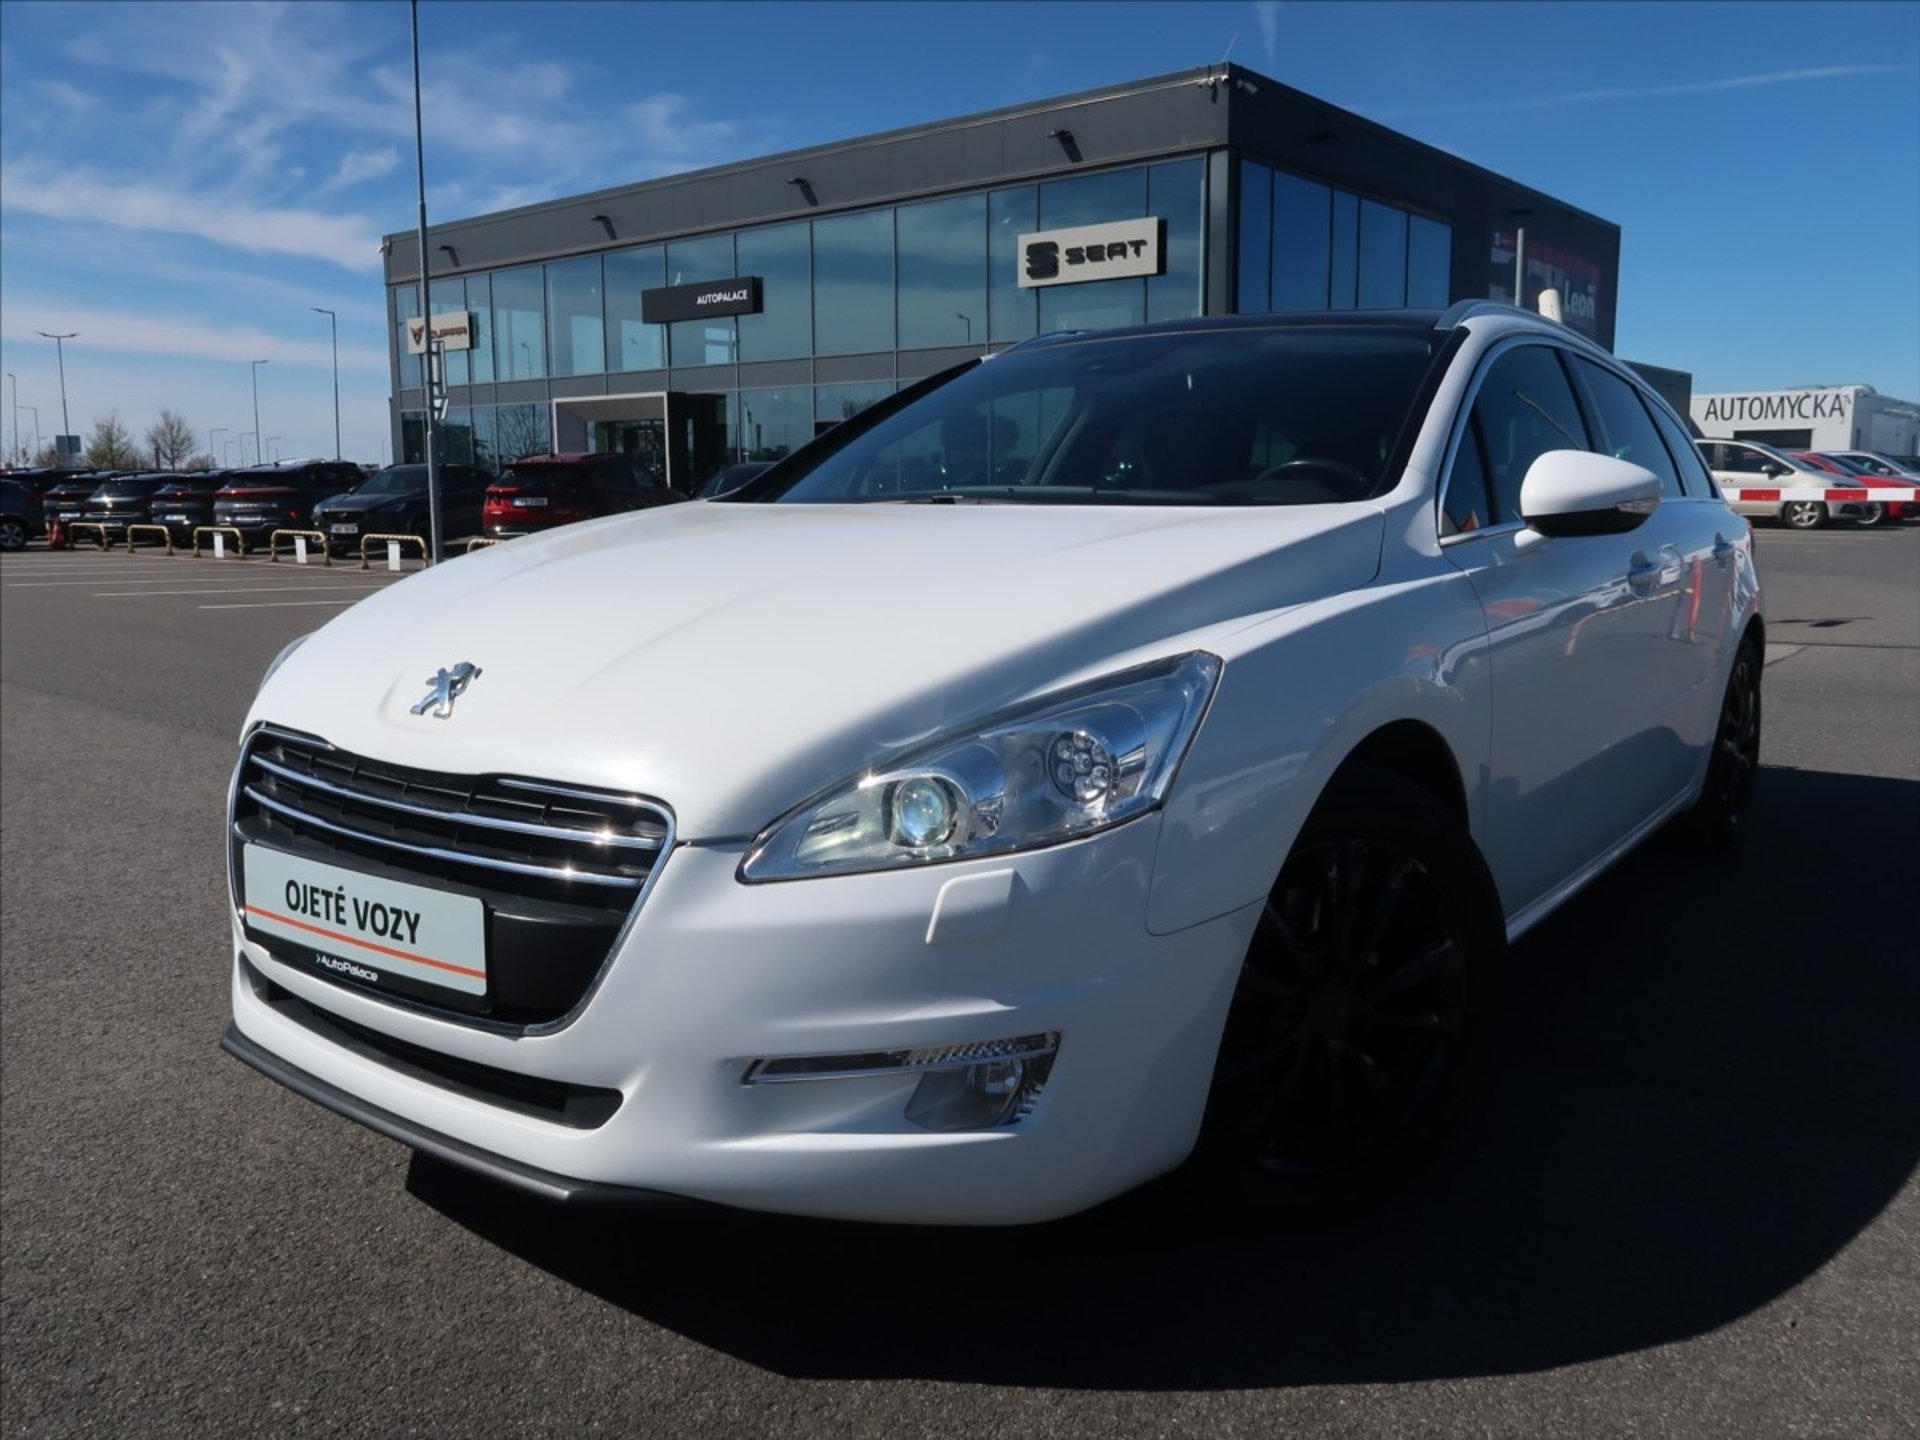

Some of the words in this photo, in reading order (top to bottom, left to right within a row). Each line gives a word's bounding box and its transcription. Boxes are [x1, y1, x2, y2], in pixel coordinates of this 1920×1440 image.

[1065, 239, 1147, 265] SEAT
[696, 289, 748, 305] AUTOPALACE
[1564, 280, 1595, 319] Leon
[1704, 392, 1845, 422] AUTOMYČKA
[285, 879, 346, 926] OJETÉ
[352, 897, 420, 944] VOZY
